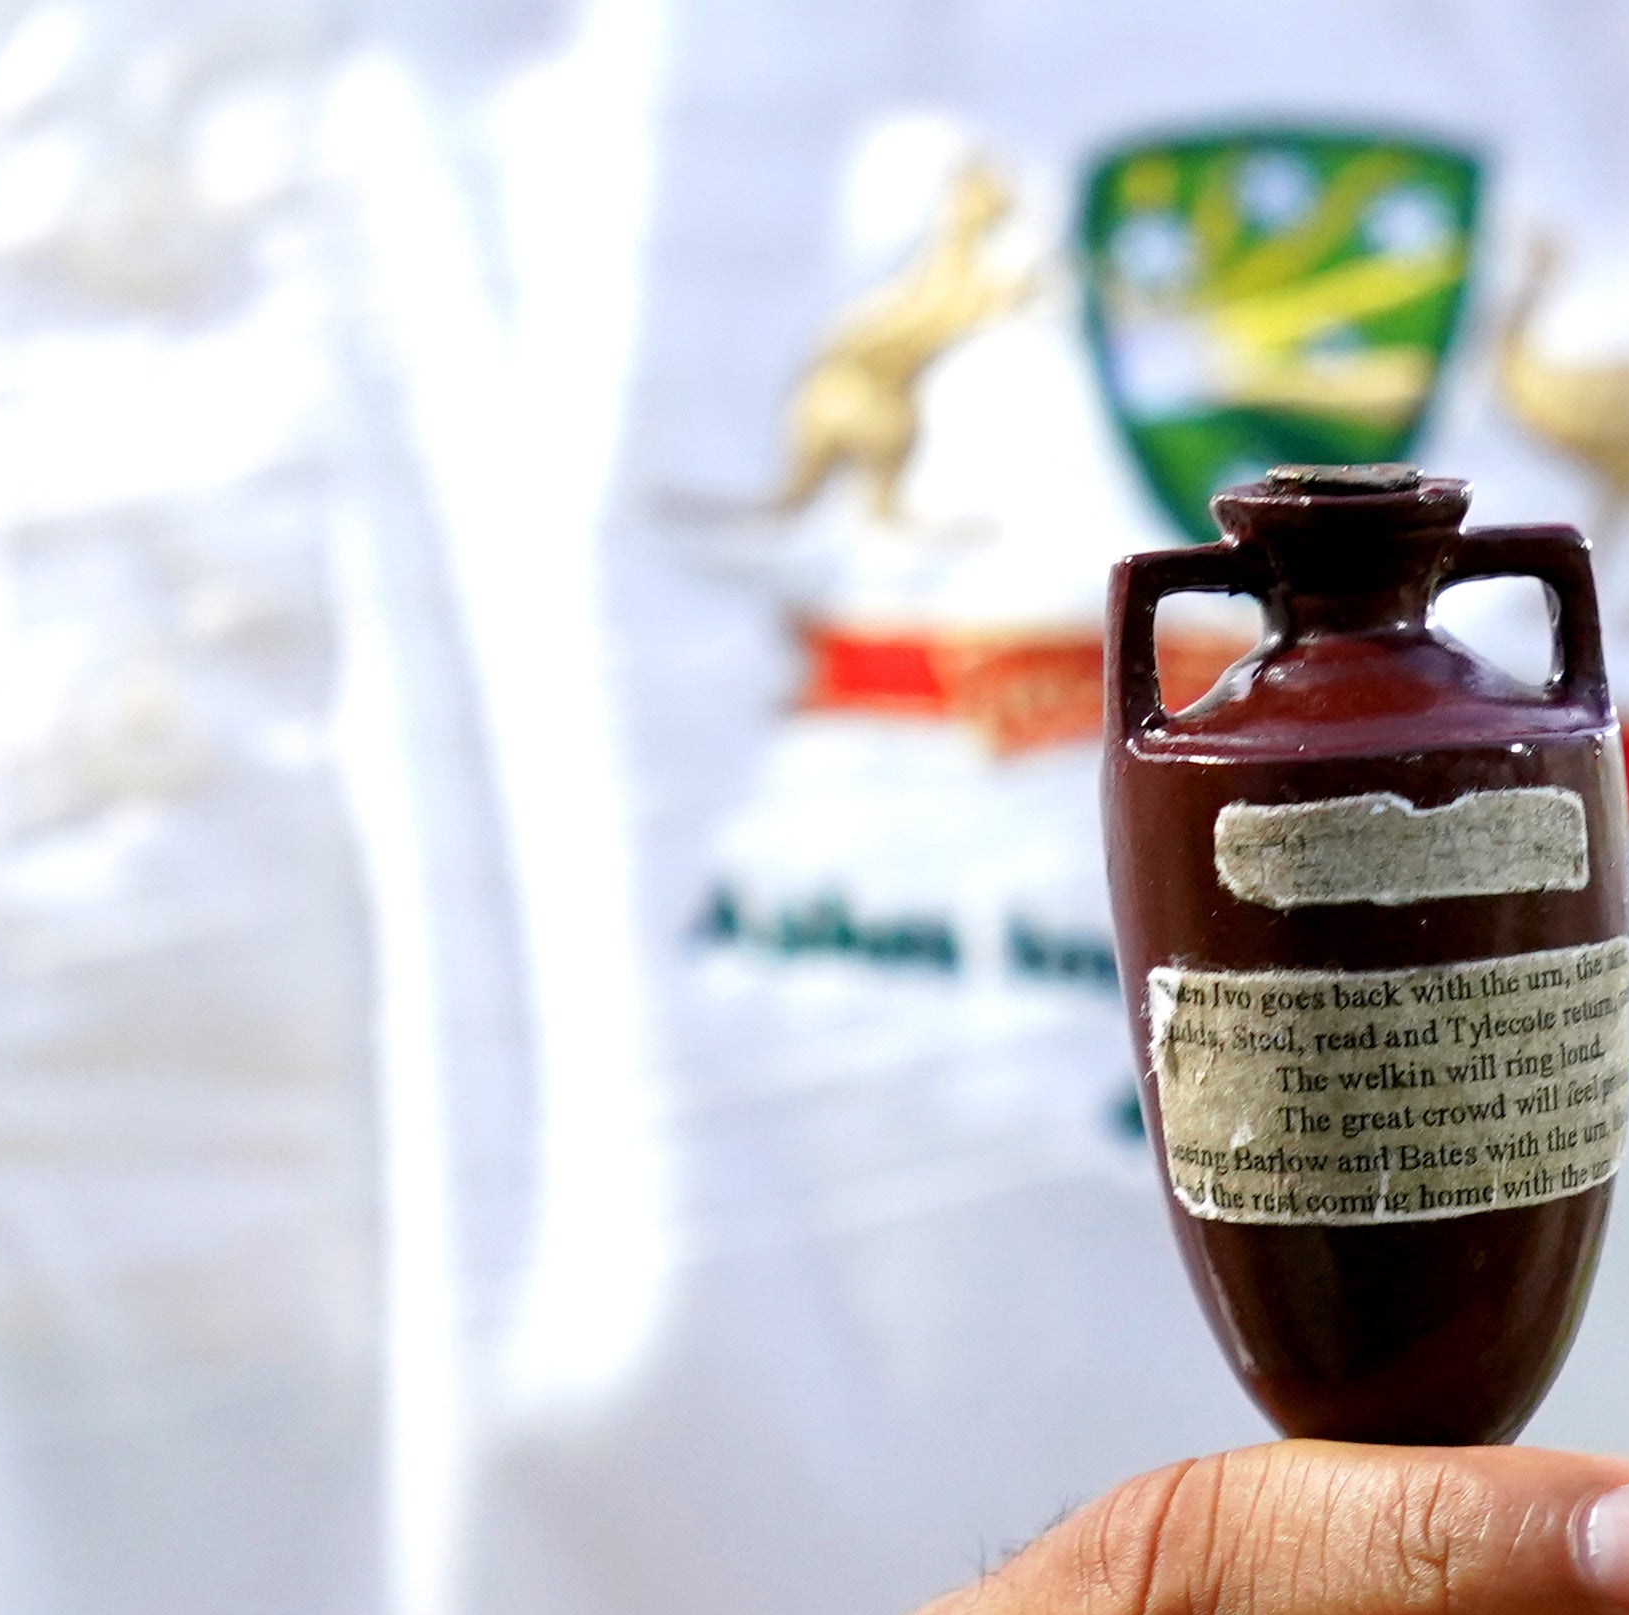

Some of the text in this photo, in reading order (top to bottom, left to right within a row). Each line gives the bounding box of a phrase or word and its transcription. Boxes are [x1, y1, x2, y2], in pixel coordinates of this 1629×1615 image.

[1212, 981, 1251, 1010] Ivo
[1261, 987, 1325, 1017] goes
[1333, 980, 1402, 1010] back
[1411, 974, 1471, 1003] with
[1480, 971, 1519, 998] the
[1576, 952, 1603, 981] the
[1313, 1024, 1376, 1055] read
[1383, 1019, 1439, 1048] and
[1447, 1008, 1556, 1048] Tylecote
[1276, 1064, 1329, 1093] The
[1339, 1060, 1435, 1091] welkin
[1445, 1053, 1497, 1084] will
[1505, 1048, 1554, 1078] ring
[1278, 1106, 1331, 1134] The
[1342, 1106, 1415, 1138] great
[1422, 1094, 1506, 1128] crowd
[1516, 1082, 1559, 1117] will
[1233, 1146, 1329, 1174] Barlow
[1337, 1147, 1389, 1173] and
[1399, 1140, 1478, 1171] Bates
[1485, 1130, 1539, 1163] with
[1547, 1125, 1578, 1152] the
[1211, 1183, 1244, 1209] the
[1306, 1186, 1409, 1215] coming
[1420, 1184, 1494, 1211] home
[1503, 1170, 1554, 1199] with
[1561, 1163, 1588, 1190] the
